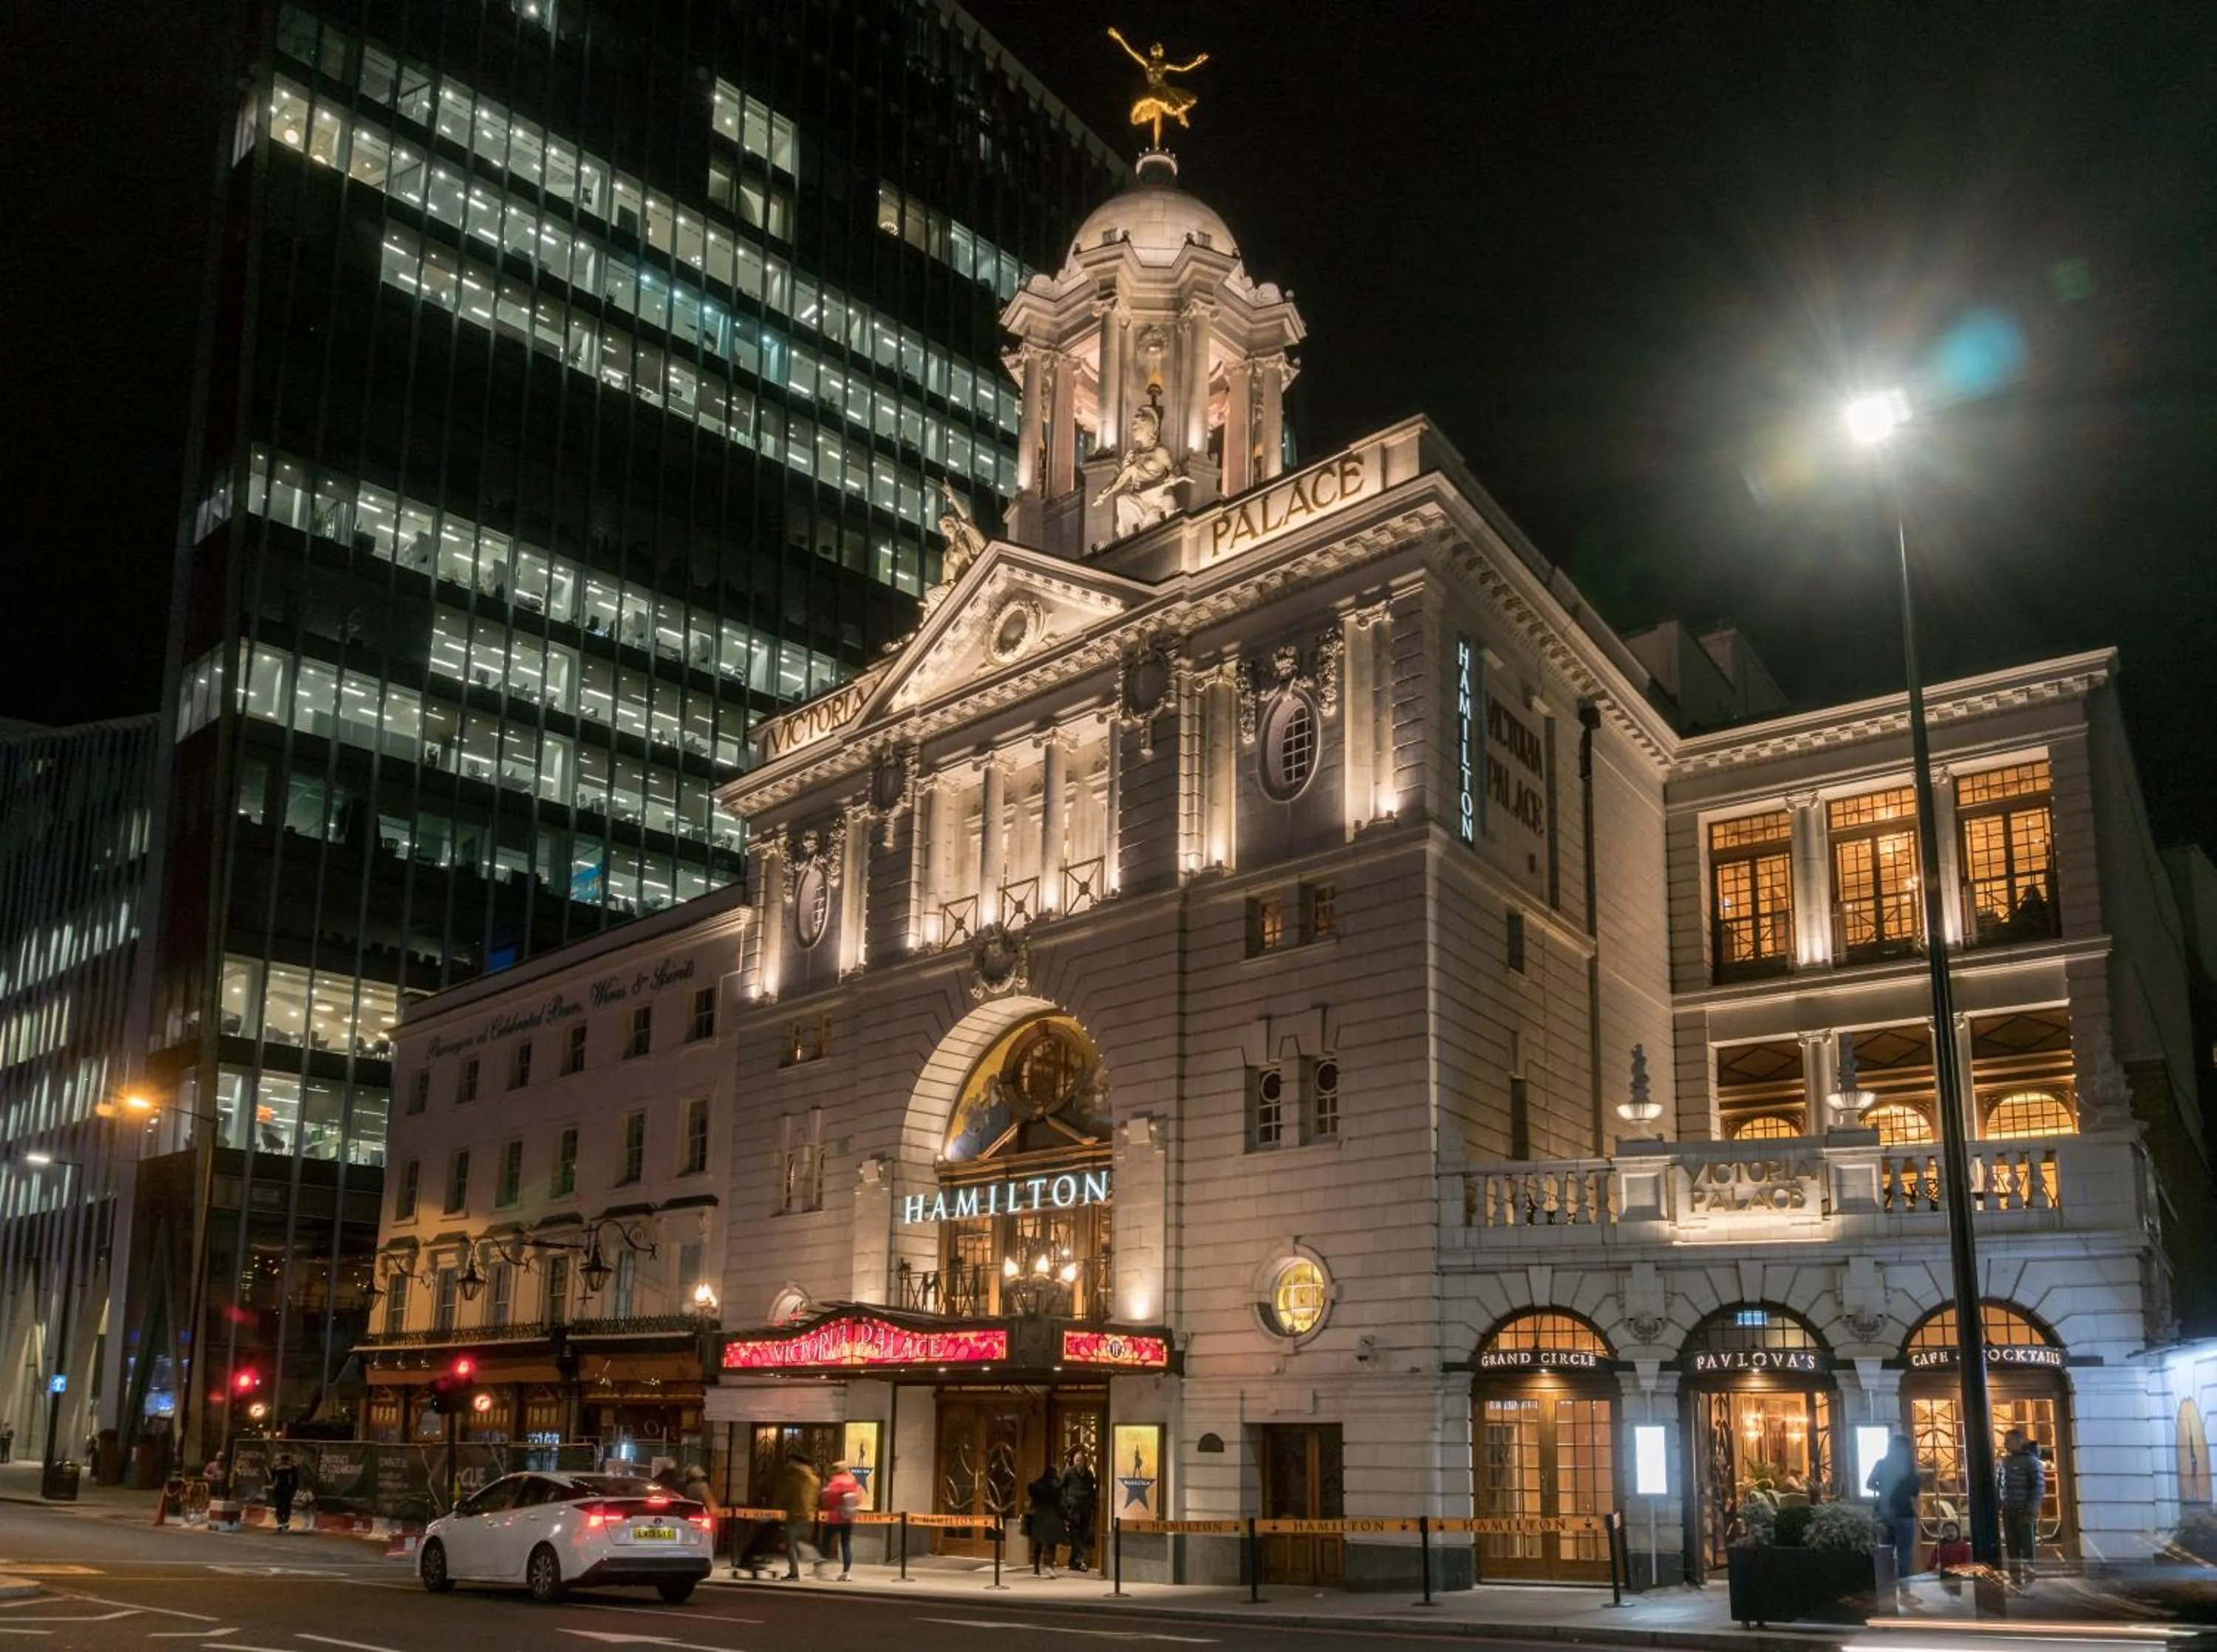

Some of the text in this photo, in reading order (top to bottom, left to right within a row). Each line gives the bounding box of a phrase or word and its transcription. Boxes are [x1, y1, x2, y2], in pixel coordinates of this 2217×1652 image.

[1212, 452, 1366, 557] PALACE
[769, 686, 865, 754] VICTORIA
[1458, 641, 1473, 842] HAMILTON
[1487, 696, 1543, 781] VICTORIA
[1487, 752, 1545, 836] PALACE
[1685, 1161, 1818, 1189] VICTORIA
[904, 1170, 1108, 1225] HAMILTON
[1690, 1187, 1808, 1213] PALACE
[772, 1322, 945, 1362] VICTORIA PALACE
[1481, 1352, 1596, 1368] GRAND CIRCLE
[1696, 1351, 1816, 1371] PAVLOVA'S
[1983, 1348, 2061, 1366] OCKTAILS
[1151, 1520, 1222, 1532] HAMILTON
[1293, 1520, 1385, 1532] HAMILTON
[1462, 1518, 1567, 1532] HAMILTON
